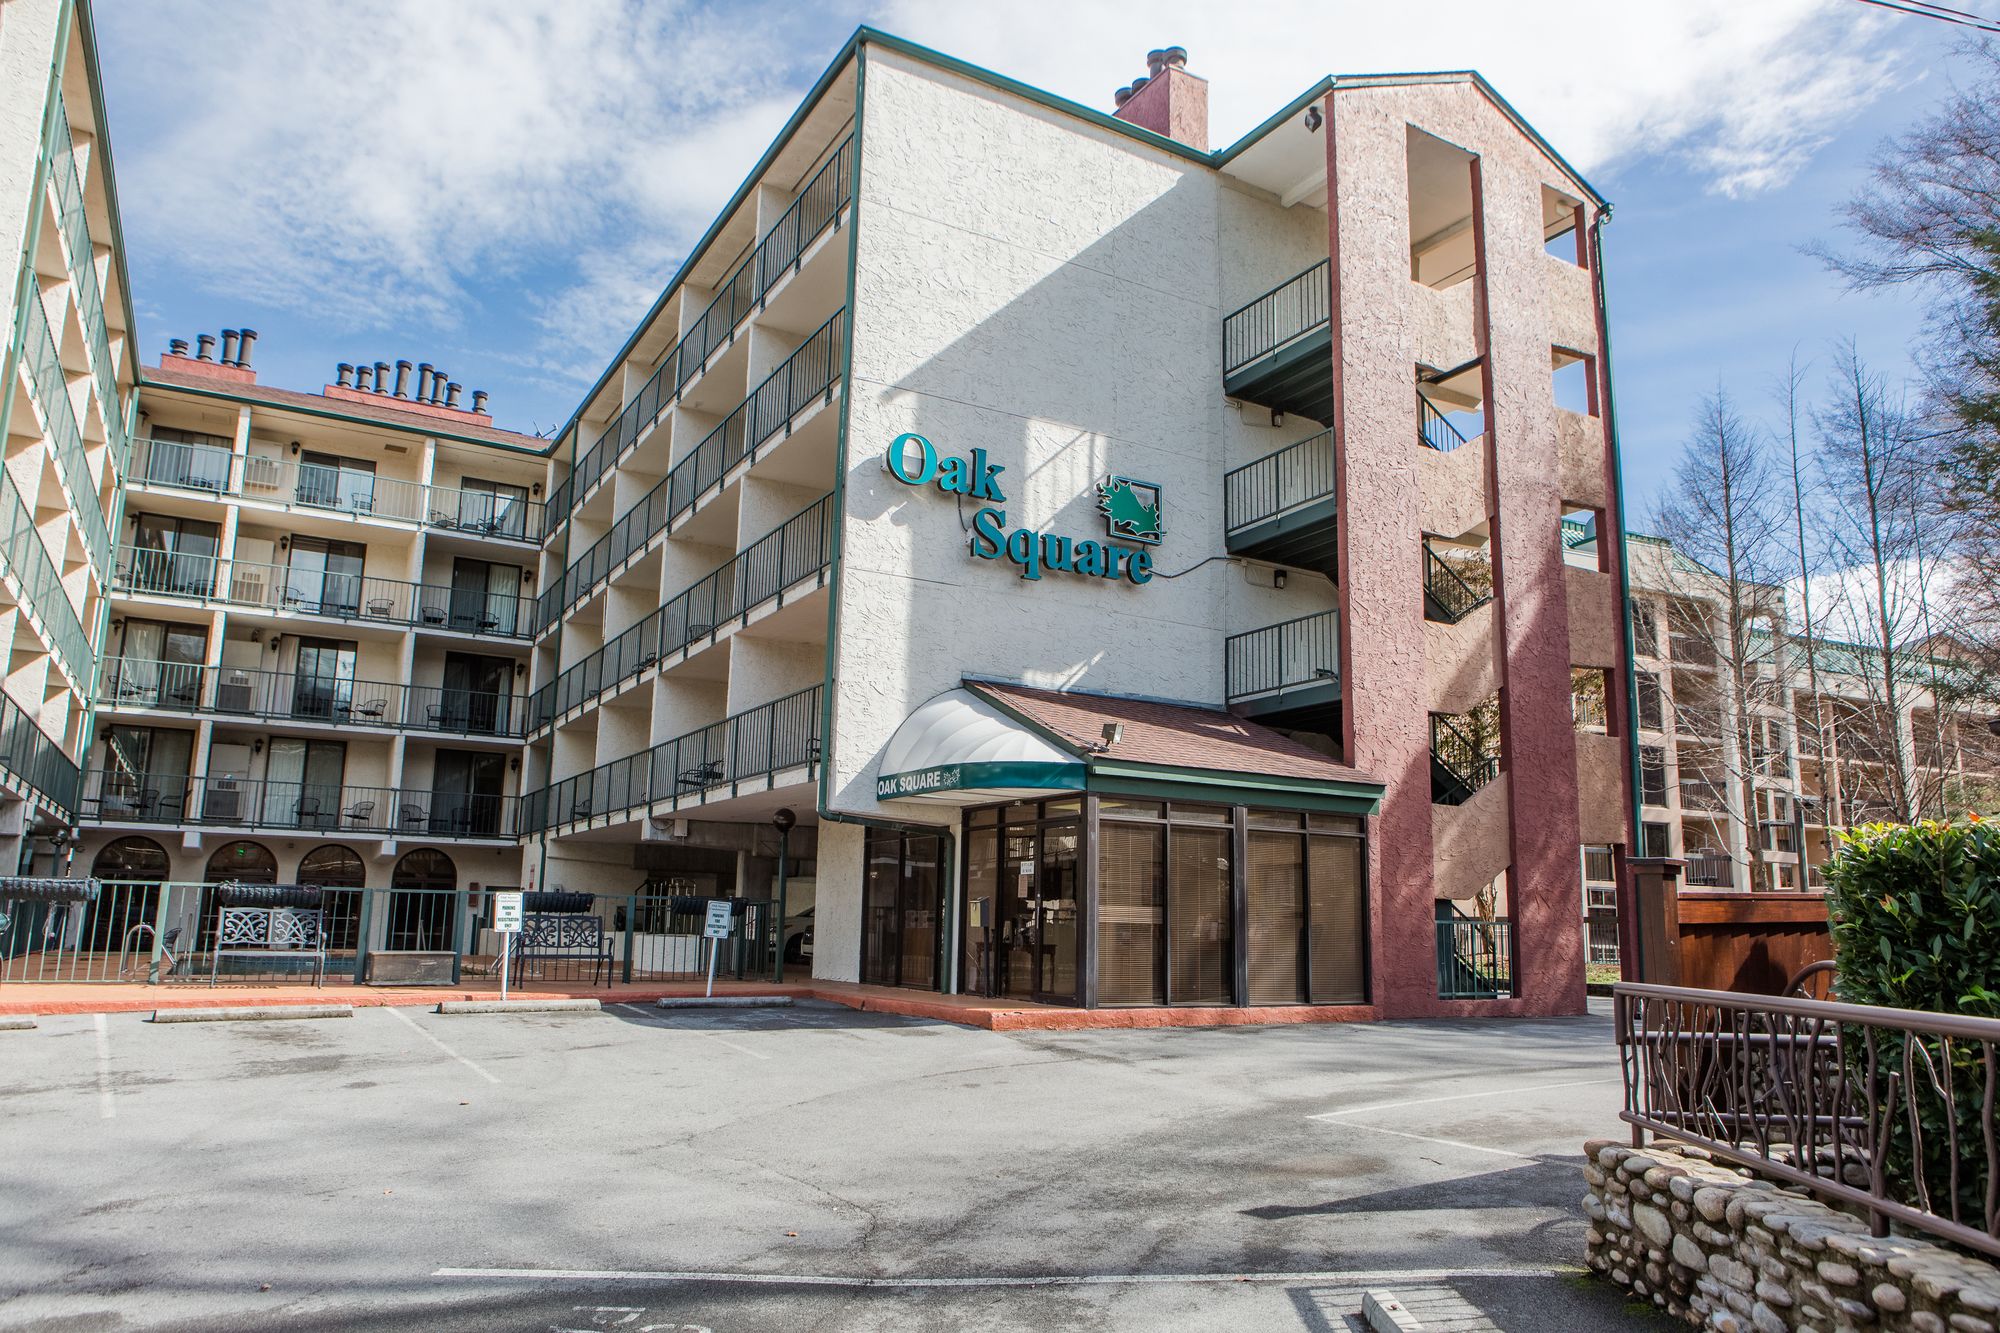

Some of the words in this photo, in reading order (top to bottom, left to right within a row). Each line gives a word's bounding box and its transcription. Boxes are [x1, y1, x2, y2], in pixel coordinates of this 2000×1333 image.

[886, 433, 1007, 503] Oak
[970, 507, 1153, 585] Square
[878, 779, 897, 795] OAK
[899, 771, 941, 792] SQUARE
